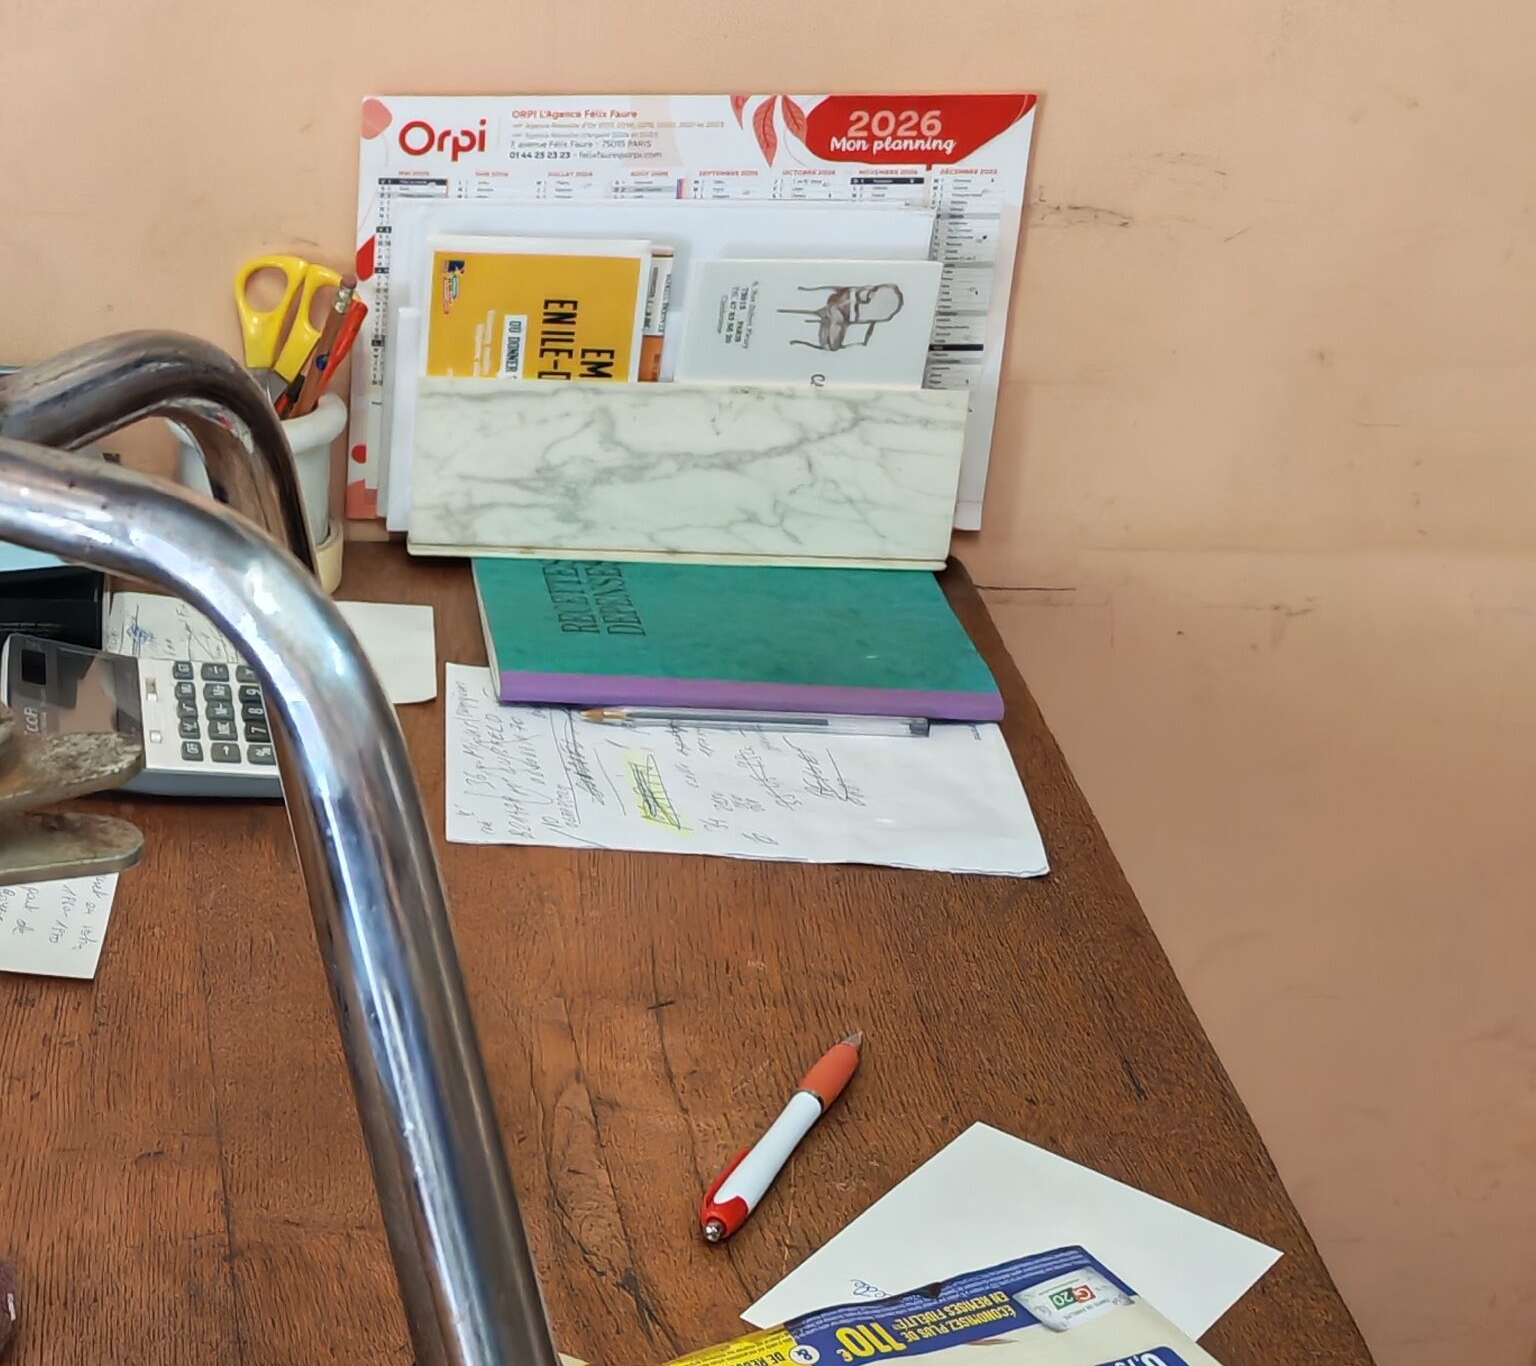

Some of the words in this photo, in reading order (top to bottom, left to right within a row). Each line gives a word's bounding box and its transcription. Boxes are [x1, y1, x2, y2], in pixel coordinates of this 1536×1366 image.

[512, 109, 537, 119] ORPI
[847, 110, 943, 138] 2026
[398, 118, 488, 162] Orpi
[830, 135, 868, 153] Mon
[872, 135, 957, 155] planning
[542, 299, 579, 326] EN
[1049, 1285, 1096, 1310] G20
[920, 1324, 949, 1340] PLUS
